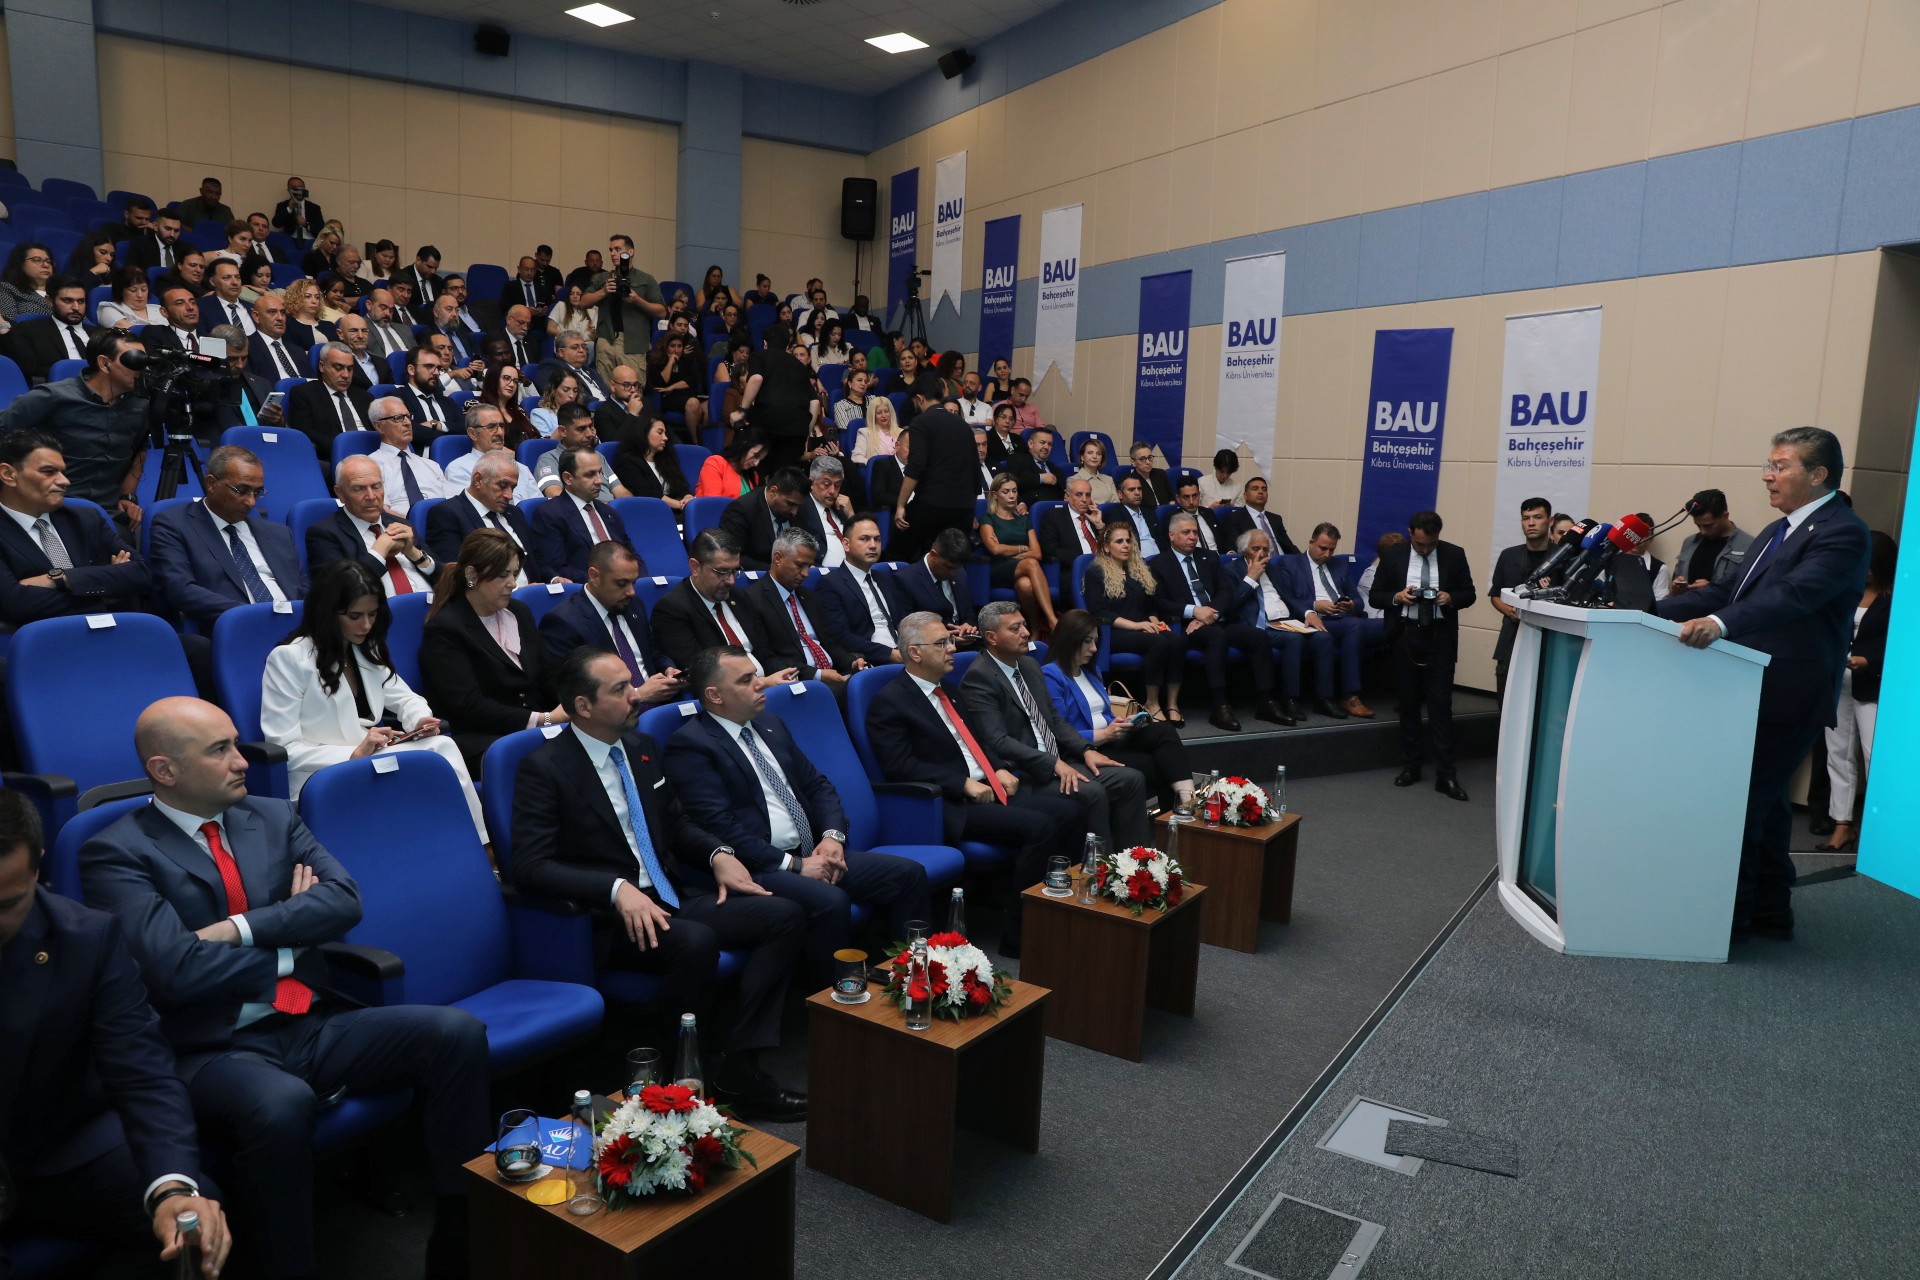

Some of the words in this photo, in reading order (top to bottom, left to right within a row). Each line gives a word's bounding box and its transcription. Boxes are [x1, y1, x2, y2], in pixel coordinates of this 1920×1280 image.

[938, 198, 962, 223] BAU
[892, 211, 914, 235] BAU
[936, 225, 961, 238] Bahçeşehir
[892, 236, 914, 249] Bahçeşehir
[985, 265, 1014, 290] BAU
[1044, 258, 1076, 284] BAU
[984, 293, 1013, 304] Bahçeşehir
[1042, 288, 1074, 300] Bahçeşehir
[1228, 318, 1276, 347] BAU
[1142, 330, 1184, 358] BAU
[1226, 354, 1274, 368] Bahçeşehir
[1142, 364, 1182, 377] Bahçeşehir
[1226, 370, 1241, 380] Kıbrıs
[1242, 368, 1274, 378] Üniversitesi
[1155, 378, 1182, 386] Üniversitesi
[1510, 390, 1588, 426] BAU
[1374, 401, 1438, 433] BAU
[1372, 441, 1434, 457] Bahçeşehir
[1508, 436, 1584, 454] Bahçeşehir
[1371, 457, 1390, 468] Kıbrıs
[1392, 457, 1434, 471] Üniversitesi
[1507, 456, 1532, 467] Kıbrıs
[1534, 455, 1584, 467] Üniversitesi
